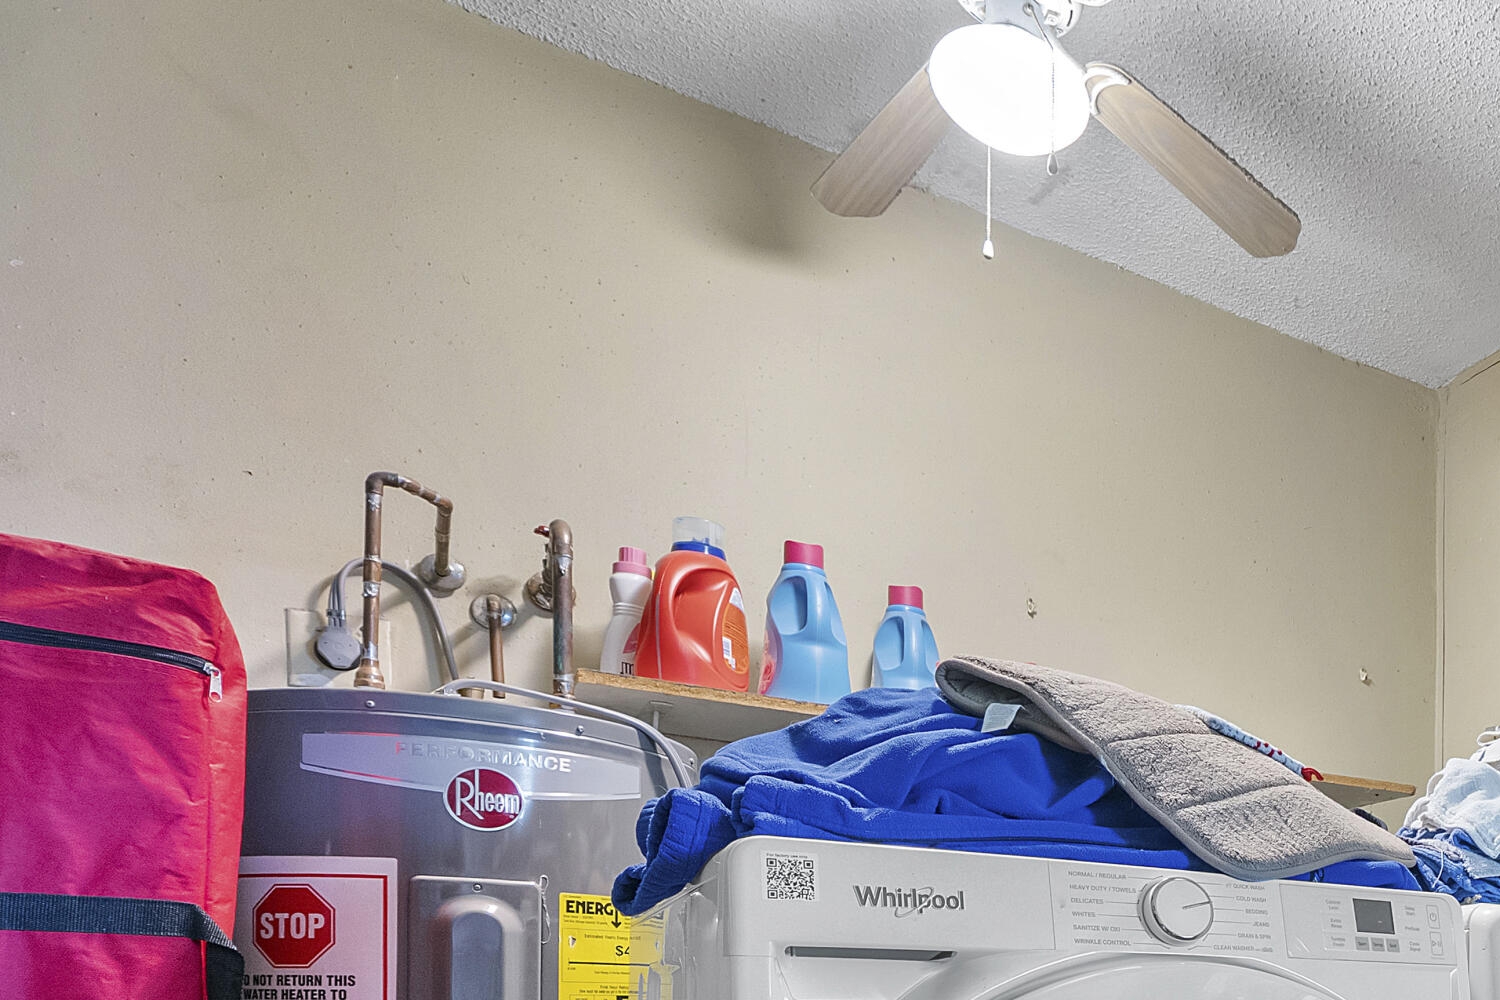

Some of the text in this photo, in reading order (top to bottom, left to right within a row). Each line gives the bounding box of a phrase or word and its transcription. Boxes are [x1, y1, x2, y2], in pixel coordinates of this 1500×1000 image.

[396, 742, 572, 773] PERFORMANCE
[456, 768, 521, 820] Rheem
[853, 885, 964, 914] Whirlpool
[260, 912, 325, 939] STOP
[243, 988, 348, 1000] WATER HEATER TO
[253, 974, 273, 987] NOT
[277, 974, 322, 987] RETURN
[326, 975, 357, 987] THIS
